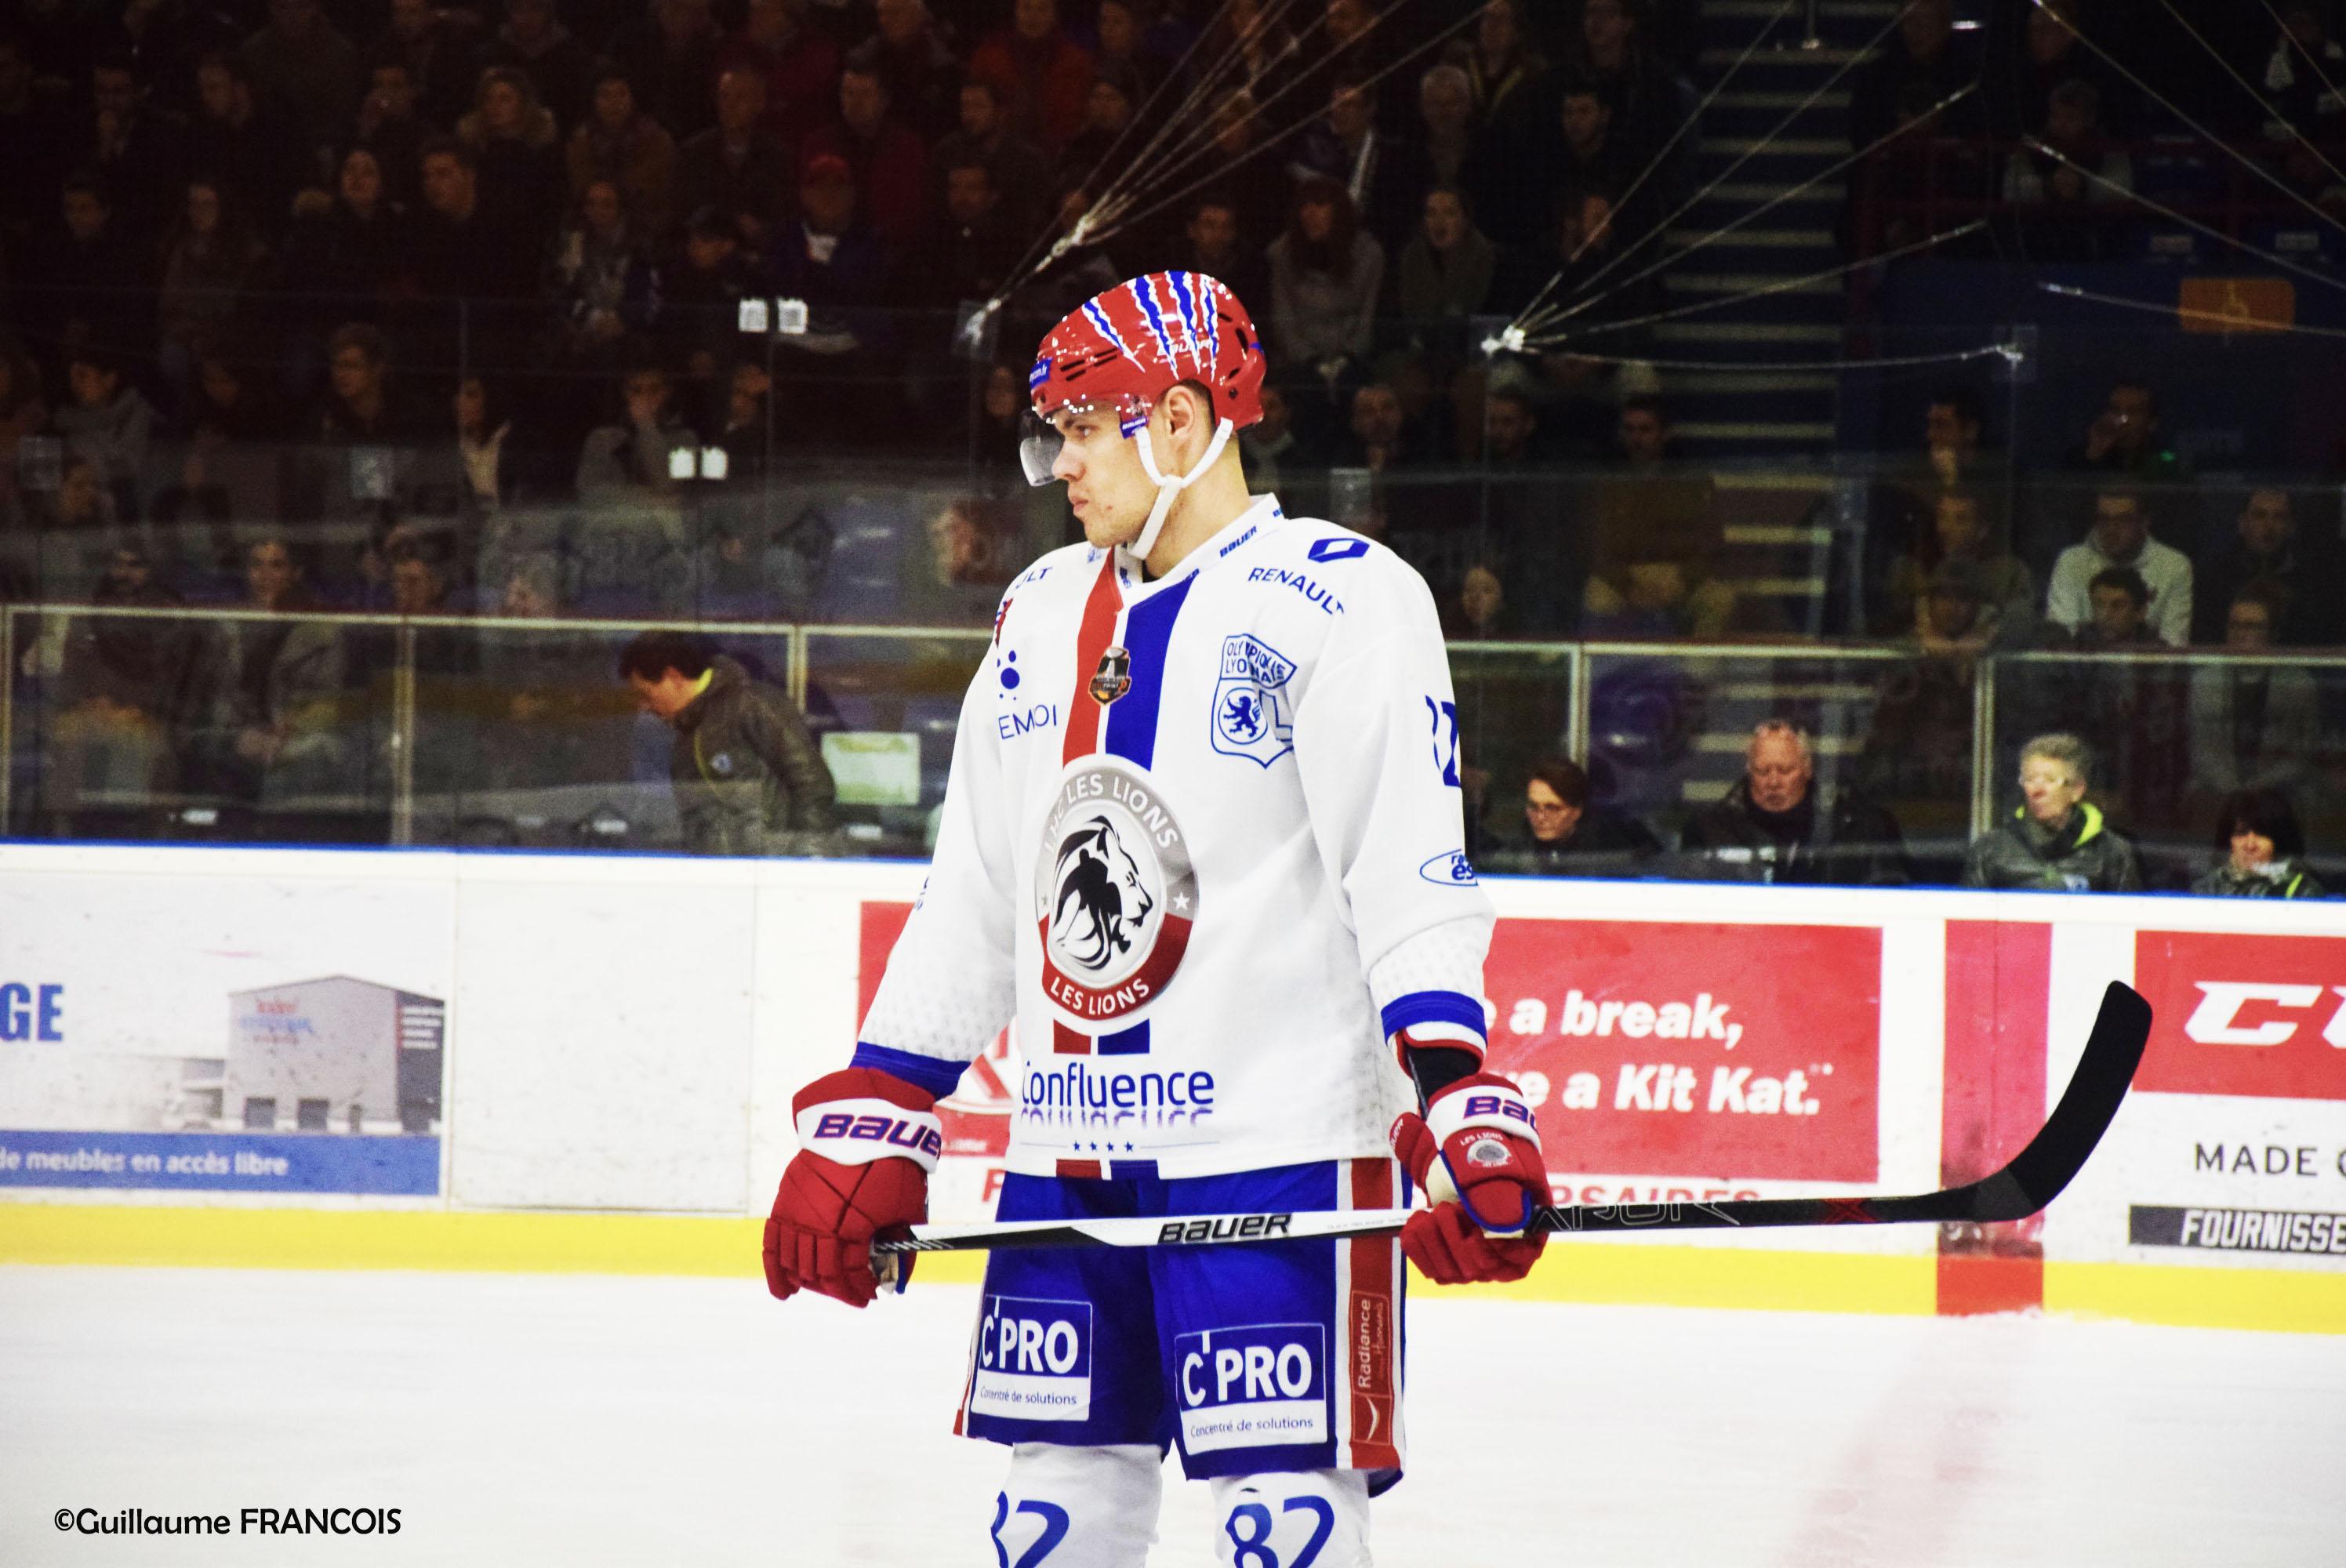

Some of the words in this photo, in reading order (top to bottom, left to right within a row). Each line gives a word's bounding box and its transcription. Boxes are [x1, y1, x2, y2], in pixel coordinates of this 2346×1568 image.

[998, 704, 1057, 739] EMOI
[1066, 773, 1104, 805] LES
[1112, 776, 1178, 848] LIONS
[0, 982, 64, 1042] GE
[1050, 976, 1084, 1011] LES
[1088, 977, 1150, 1016] LIONS
[1509, 998, 1547, 1035] a
[1560, 990, 1743, 1051] break,
[1563, 1071, 1600, 1109] a
[1614, 1063, 1698, 1112] Kit
[26, 1148, 125, 1173] meubles
[131, 1153, 161, 1173] en
[235, 1151, 289, 1175] libre
[2195, 1142, 2318, 1176] MADE
[1357, 1298, 1371, 1388] Radiance
[1011, 1390, 1022, 1403] de
[1025, 1392, 1077, 1406] solutions
[1237, 1419, 1252, 1432] de
[1256, 1417, 1314, 1430] solutions
